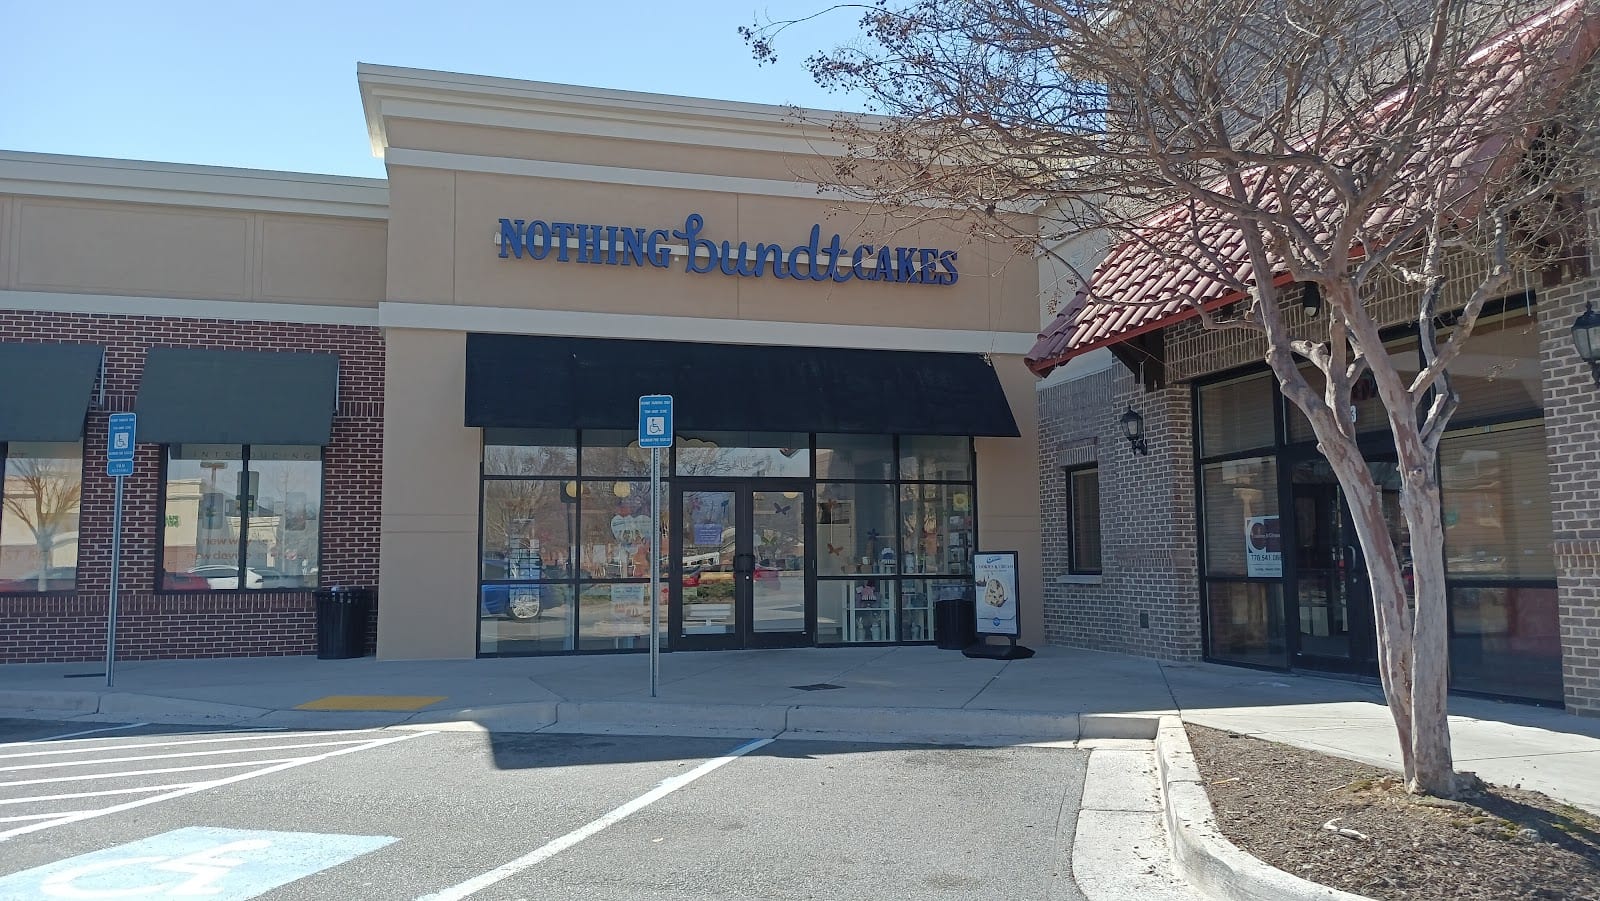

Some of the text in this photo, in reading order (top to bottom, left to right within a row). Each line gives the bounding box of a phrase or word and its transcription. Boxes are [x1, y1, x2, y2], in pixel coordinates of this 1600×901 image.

[498, 213, 959, 286] NOTHING bundt CAKES
